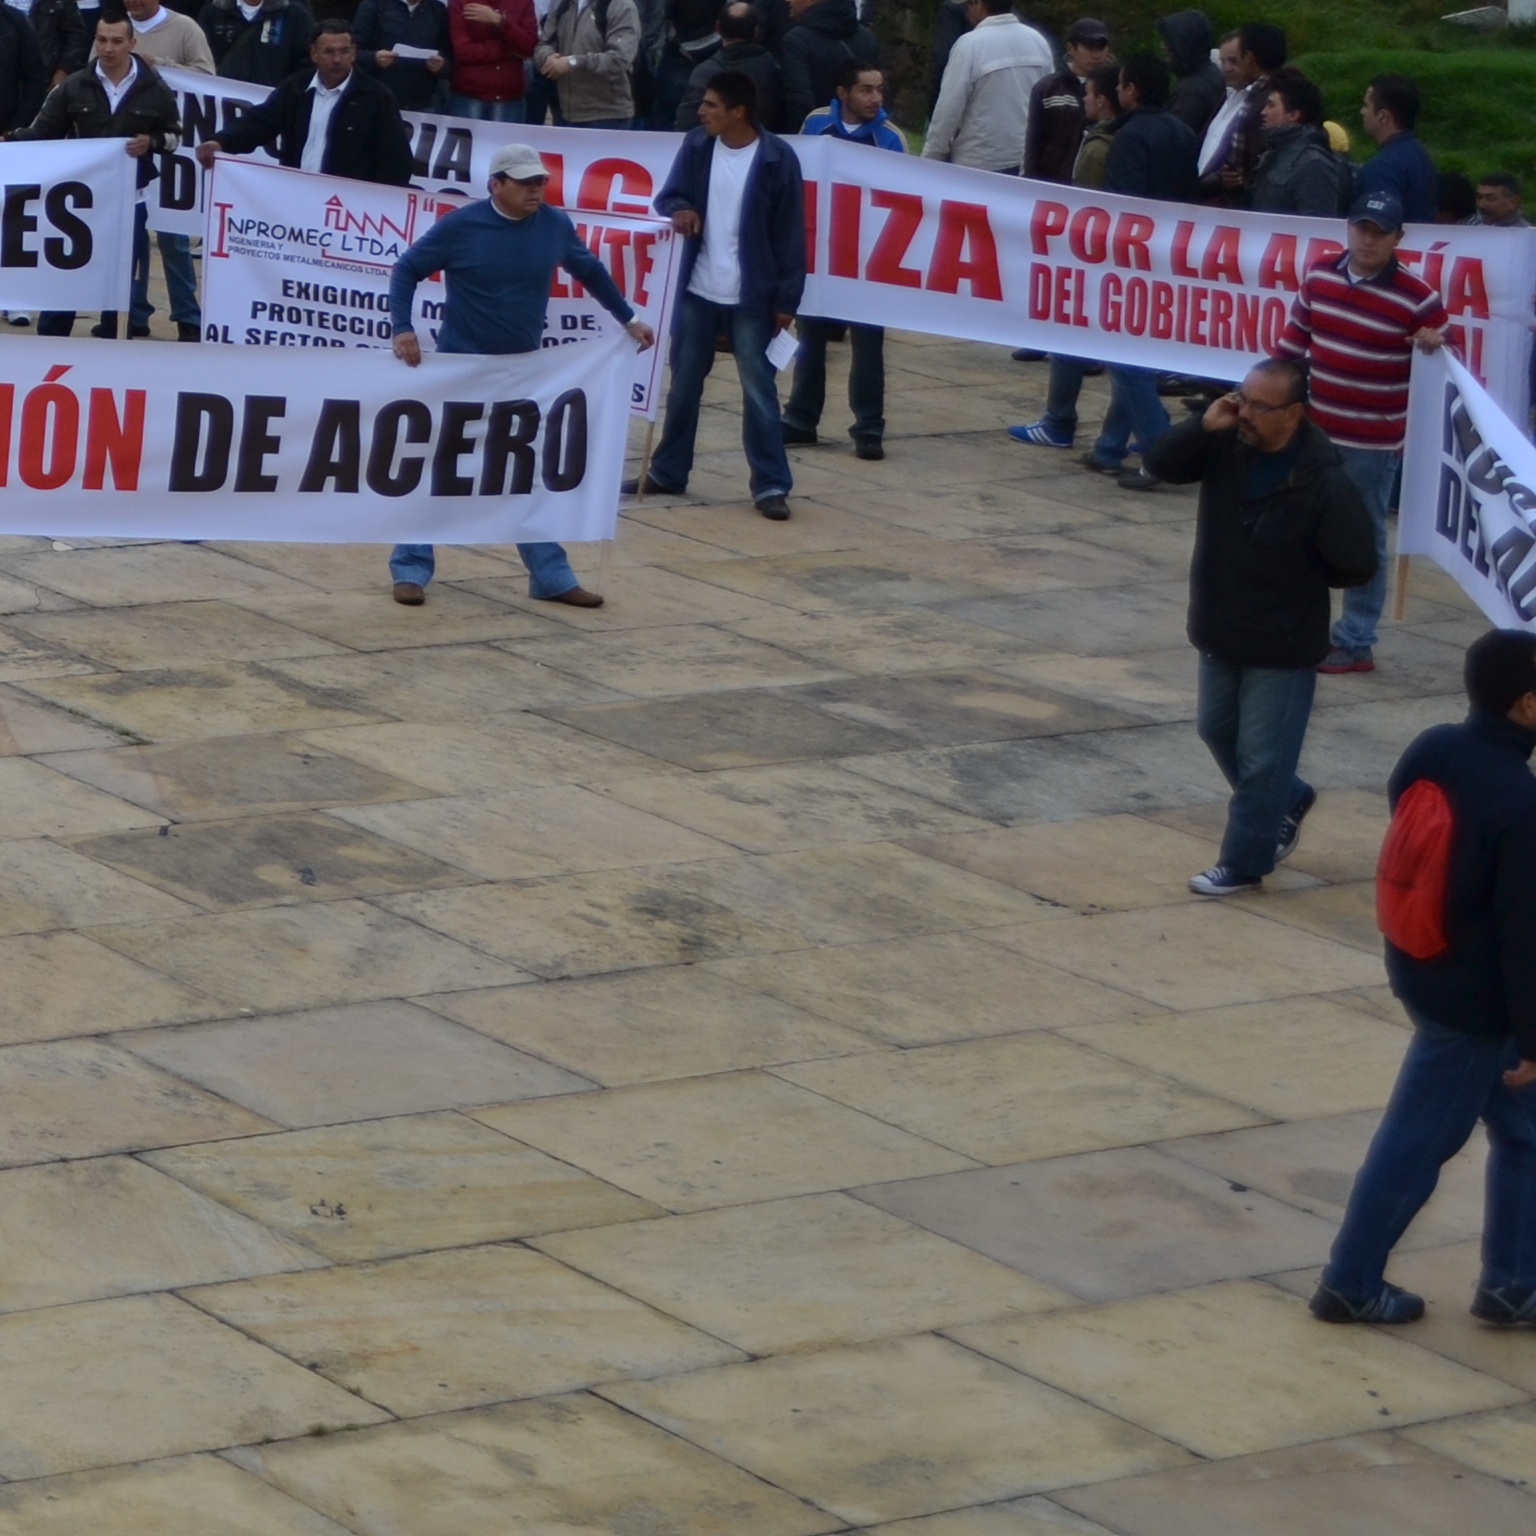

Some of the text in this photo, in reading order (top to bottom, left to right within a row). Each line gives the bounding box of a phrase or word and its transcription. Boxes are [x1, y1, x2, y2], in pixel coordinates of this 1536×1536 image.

[228, 245, 281, 261] PROYECTOS
[282, 253, 363, 274] METALMECANICOS
[1030, 199, 1151, 272] POR
[1170, 221, 1243, 285] LA
[282, 278, 391, 313] EXIGIMO
[1029, 262, 1287, 356] DEL GOBIERNO
[205, 323, 235, 345] AL
[250, 300, 393, 340] PROTECCIÓ
[168, 390, 286, 494] DE
[299, 387, 588, 498] ACERO
